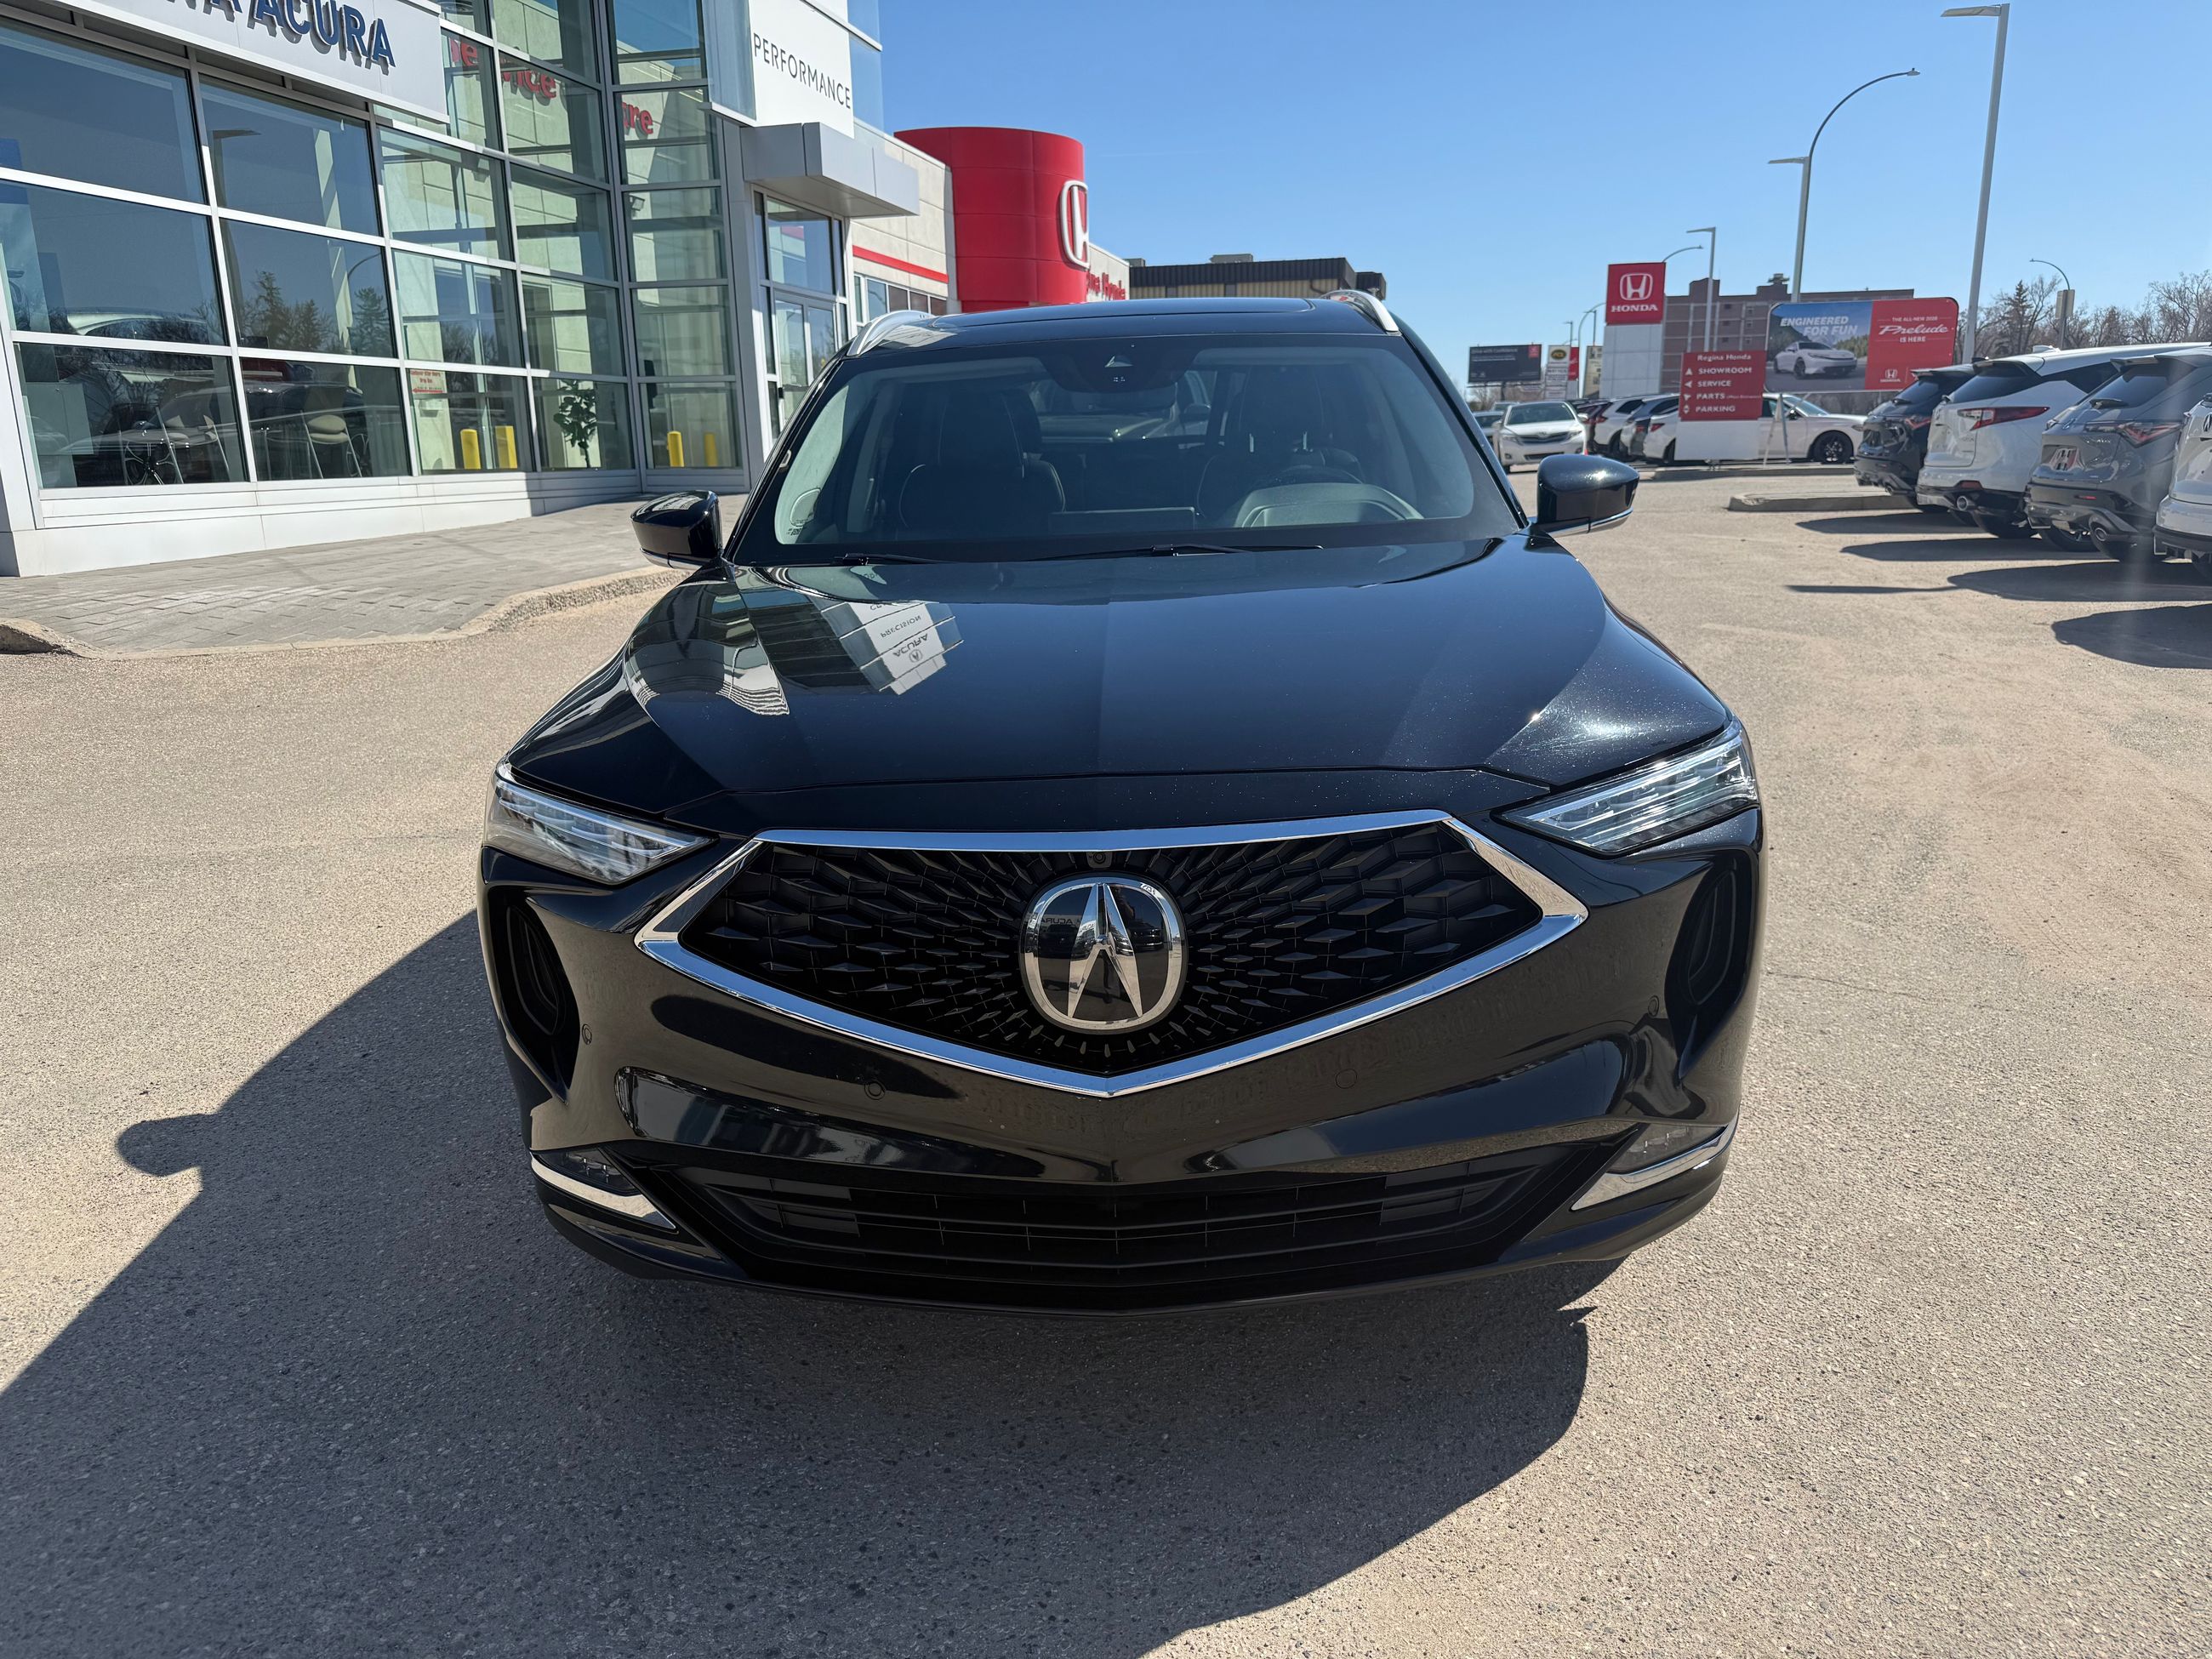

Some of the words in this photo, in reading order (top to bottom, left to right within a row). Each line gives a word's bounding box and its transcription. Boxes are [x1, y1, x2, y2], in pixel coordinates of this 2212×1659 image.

[255, 0, 396, 67] ACURA
[754, 32, 851, 109] PERFORMANCE
[1611, 304, 1658, 313] HONDA
[1780, 316, 1850, 327] ENGINEERED
[1804, 326, 1829, 336] FOR
[1831, 325, 1858, 335] FUN
[1878, 323, 1948, 334] Prelude
